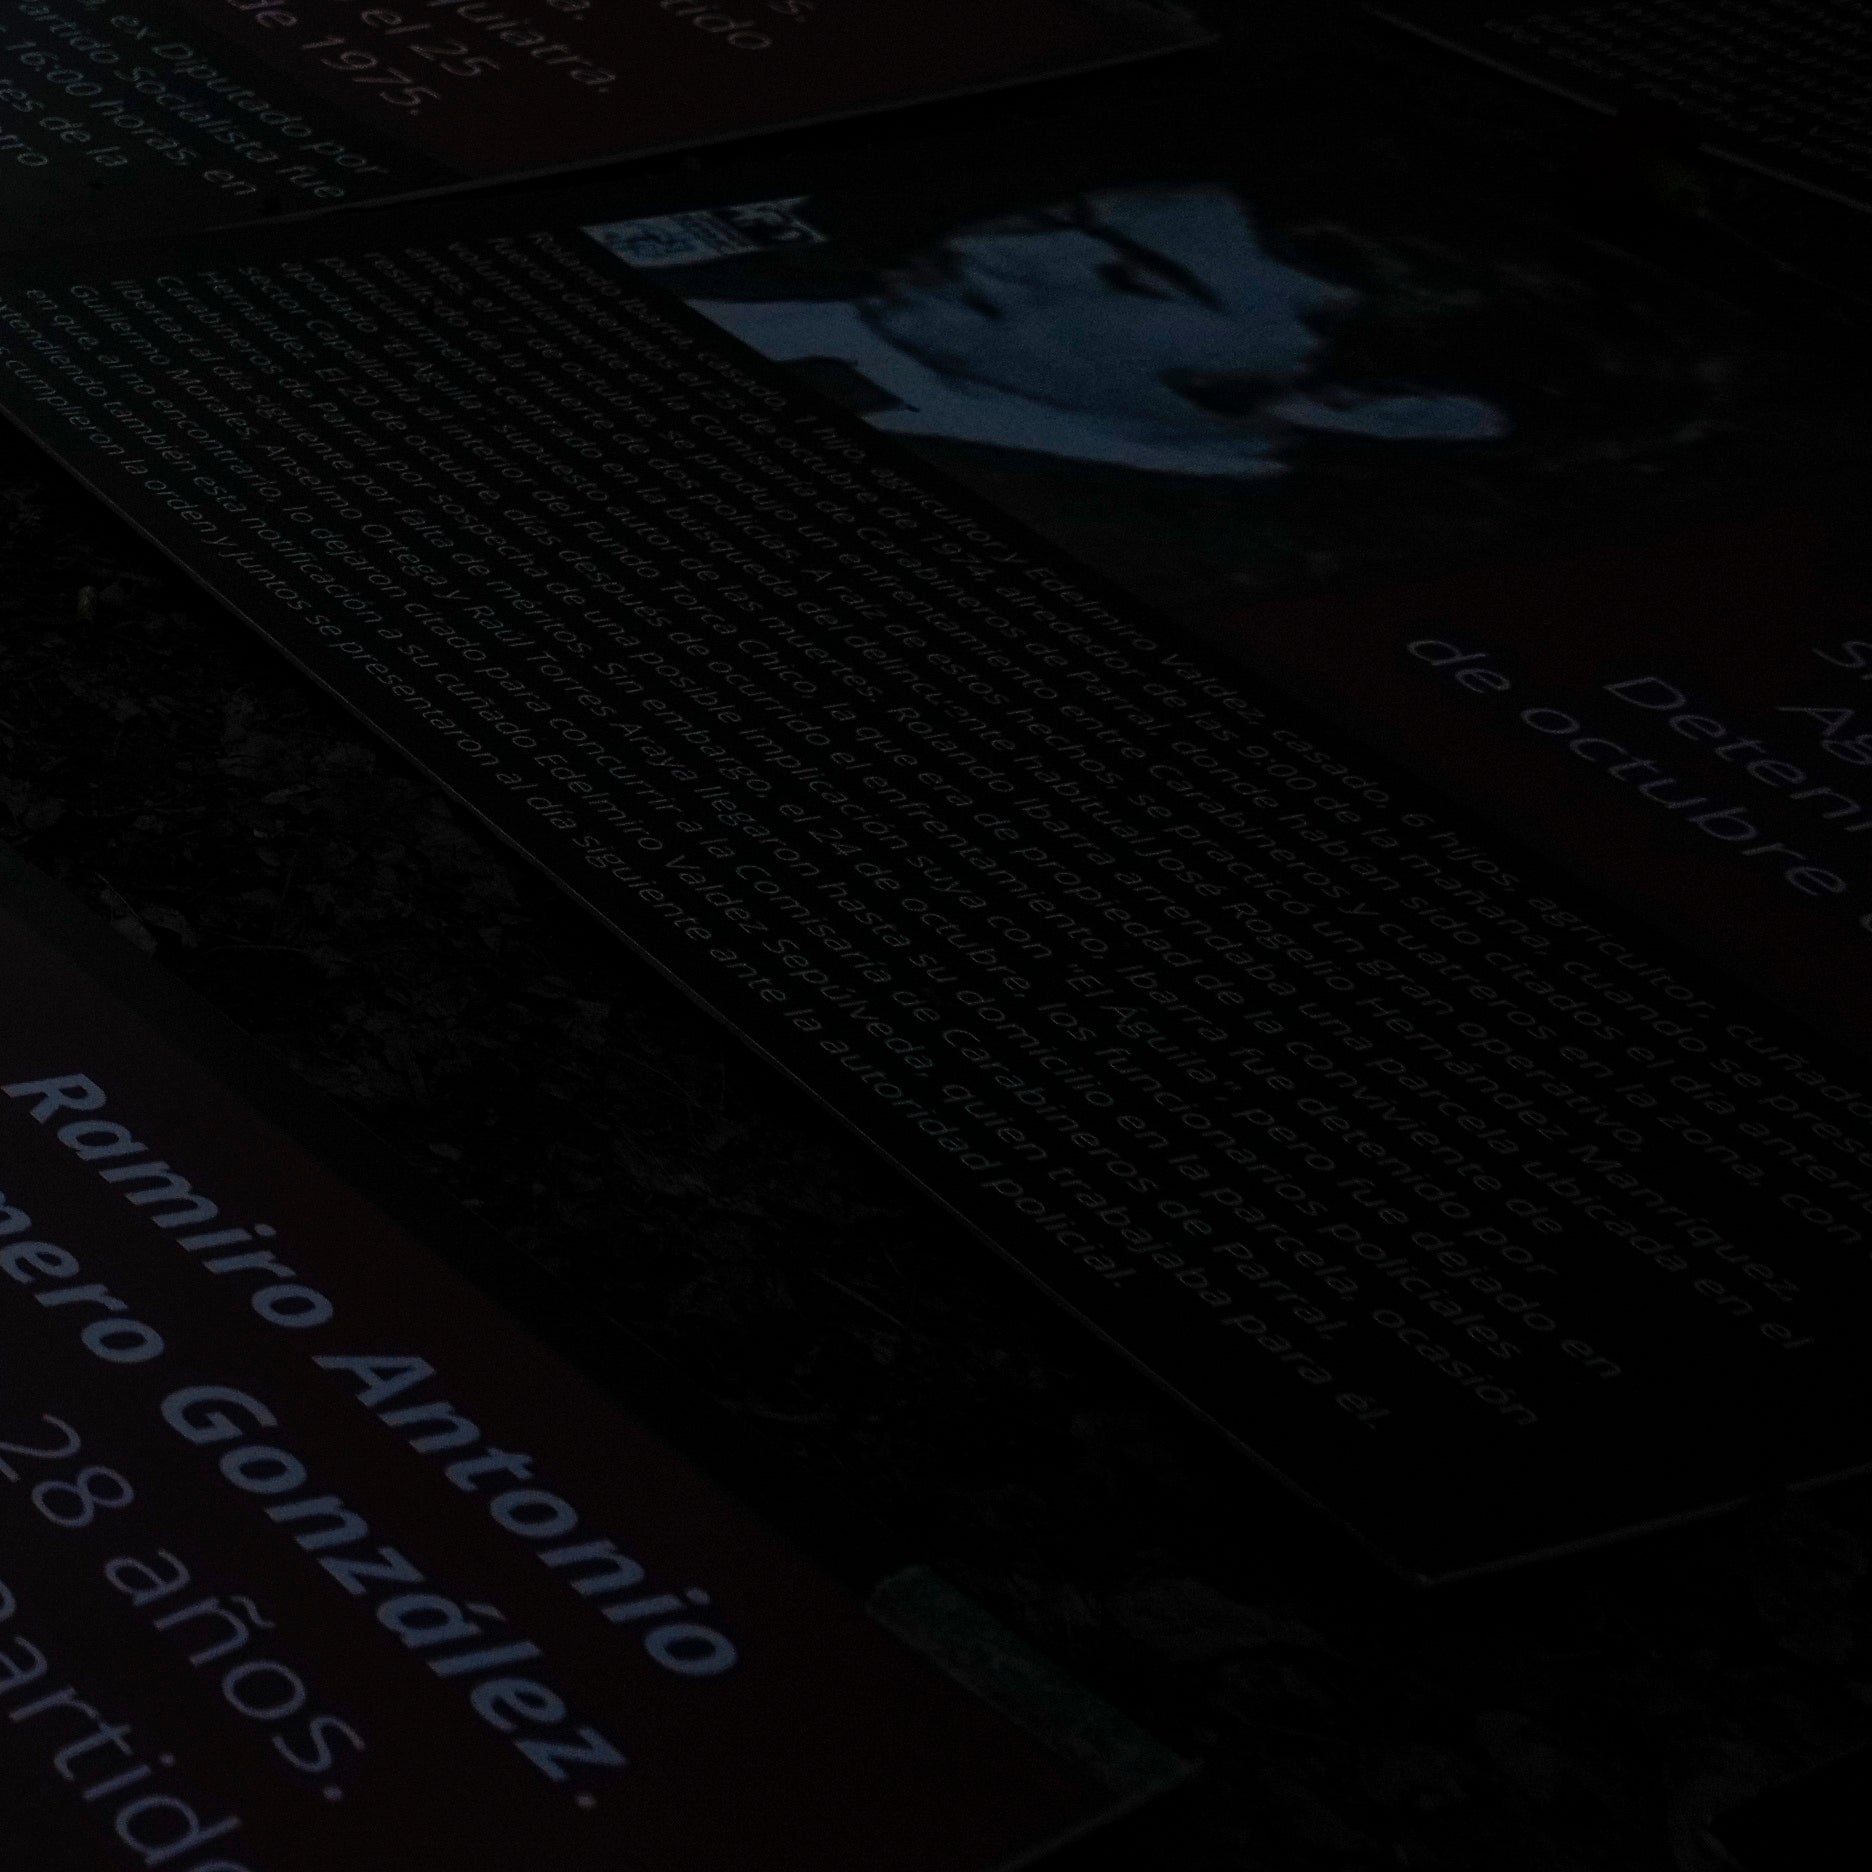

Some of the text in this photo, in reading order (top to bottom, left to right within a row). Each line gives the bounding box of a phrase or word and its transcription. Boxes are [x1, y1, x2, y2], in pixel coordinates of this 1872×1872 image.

[301, 35, 440, 117] 1975.
[360, 9, 432, 35] el
[409, 40, 500, 77] 25
[1407, 639, 1848, 896] de octubre
[708, 944, 1138, 1288] ante la autoridad policial.
[1, 1073, 737, 1676] Ramiro Antonio
[103, 1548, 366, 1802] años.
[161, 1385, 626, 1811] González.
